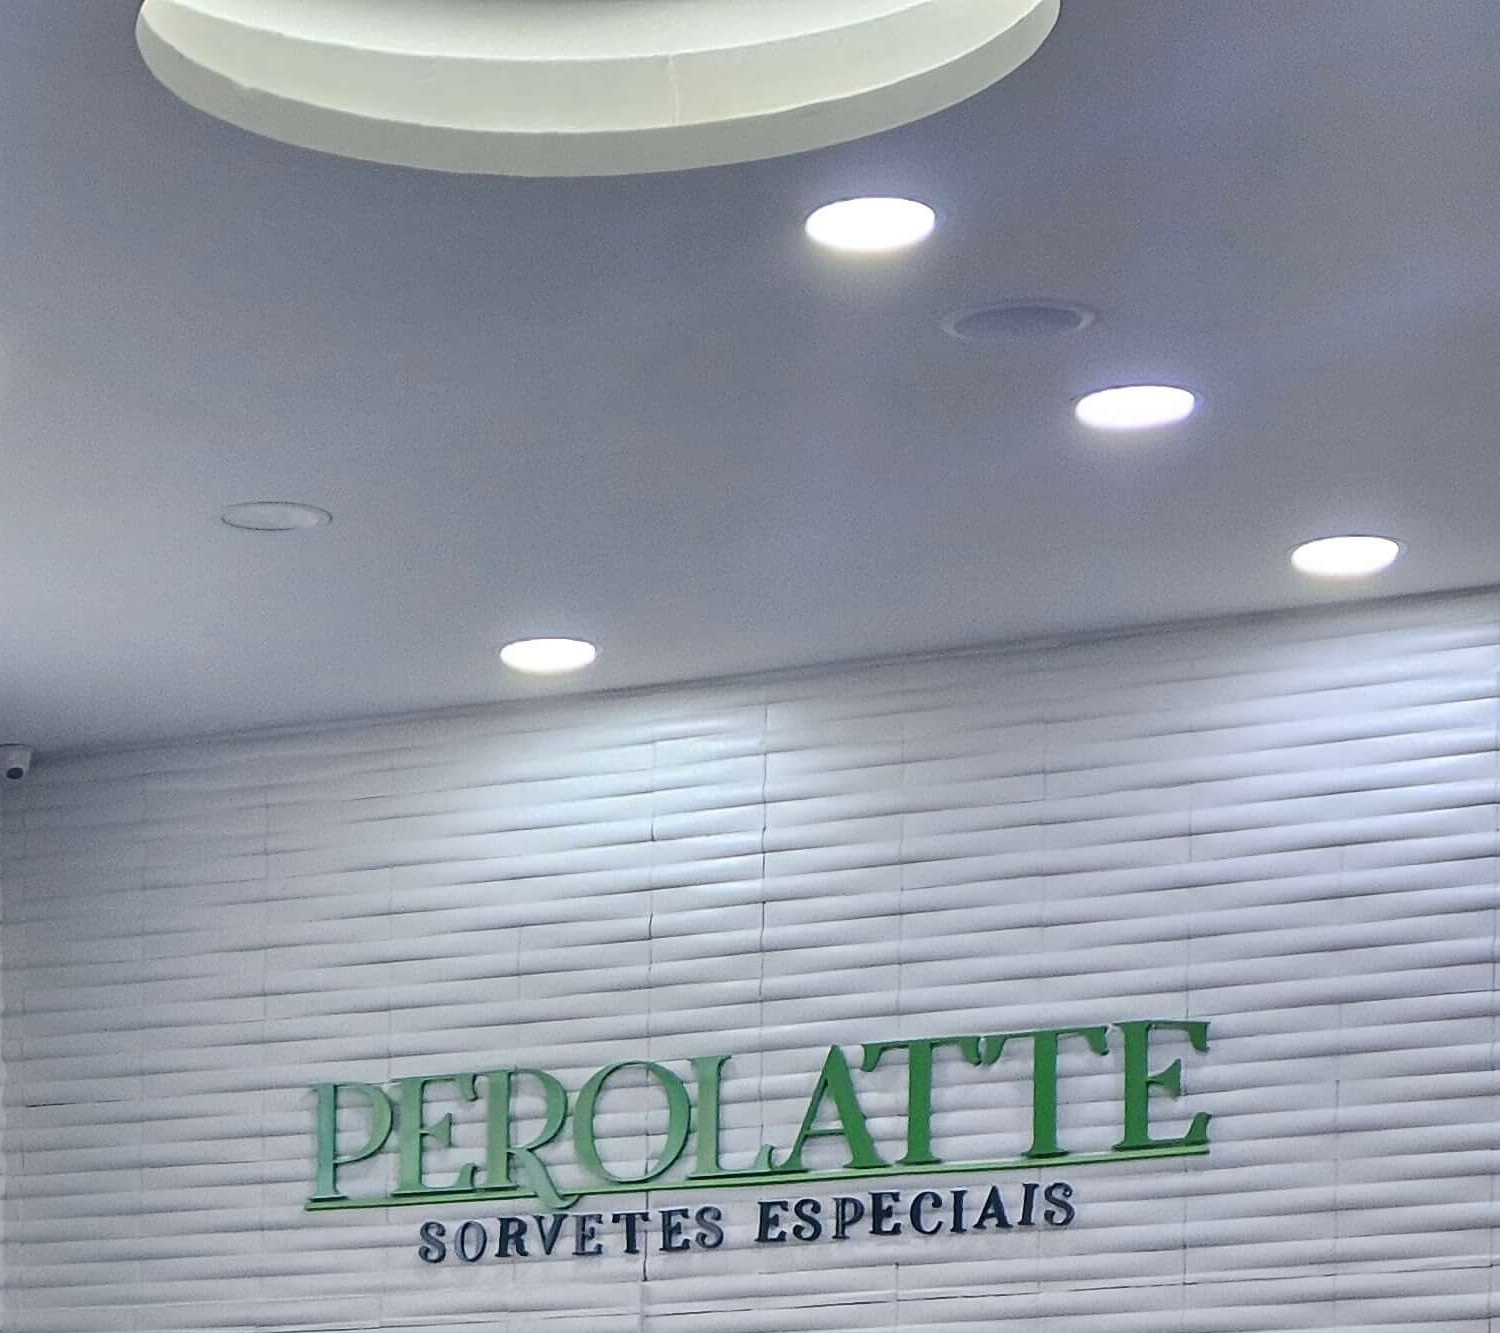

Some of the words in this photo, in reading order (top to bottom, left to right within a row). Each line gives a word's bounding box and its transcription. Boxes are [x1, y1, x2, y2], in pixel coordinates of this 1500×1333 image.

[307, 1019, 1212, 1210] PEROLATTE
[418, 1207, 724, 1264] SORVETES
[754, 1181, 1076, 1243] ESPECIAIS
